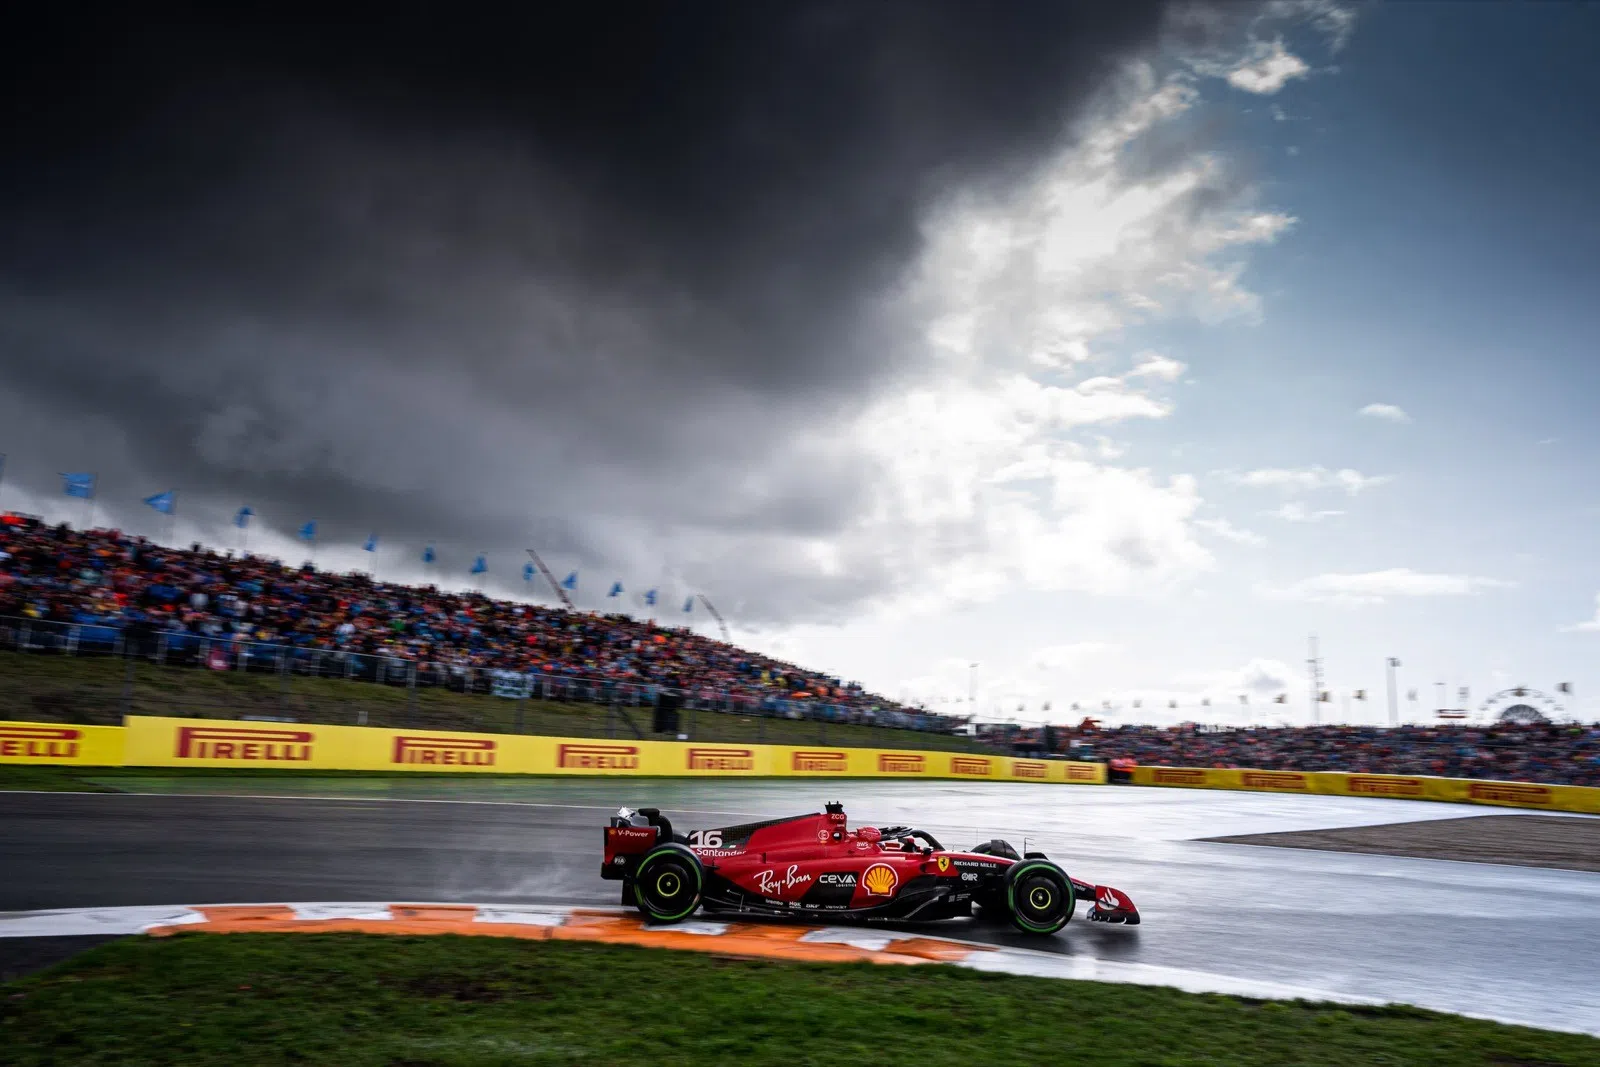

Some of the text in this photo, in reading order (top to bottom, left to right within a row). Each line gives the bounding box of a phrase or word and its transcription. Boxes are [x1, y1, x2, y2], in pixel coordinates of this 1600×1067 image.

[175, 726, 314, 761] PIRELLI
[392, 736, 495, 766] PIRELLI
[557, 744, 639, 769] PIRELLI
[688, 748, 753, 770] PIRELLI
[617, 829, 649, 837] V-Power
[689, 830, 723, 848] 16
[696, 848, 746, 857] Santander
